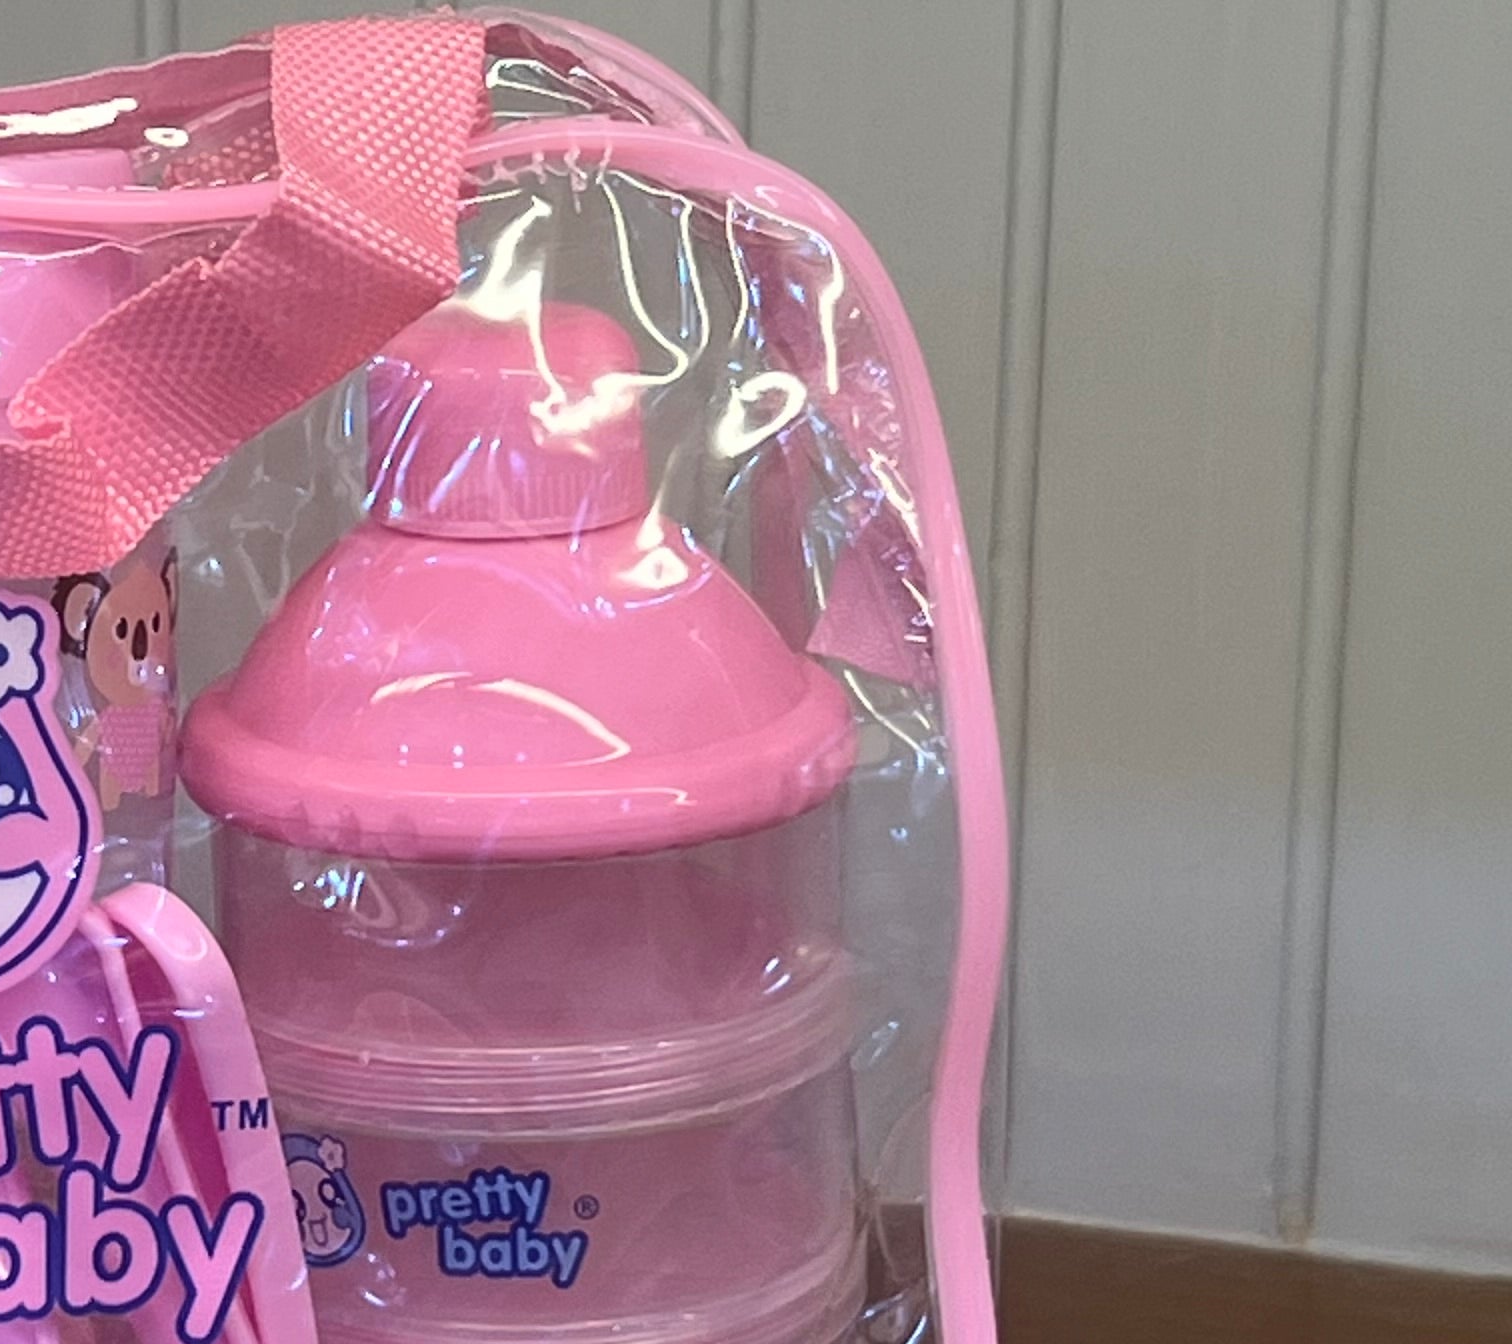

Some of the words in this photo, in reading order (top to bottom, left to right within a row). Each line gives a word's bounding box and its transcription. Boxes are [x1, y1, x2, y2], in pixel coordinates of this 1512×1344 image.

[214, 1099, 270, 1131] TM
[380, 1166, 550, 1239] pretty
[438, 1222, 588, 1289] baby
